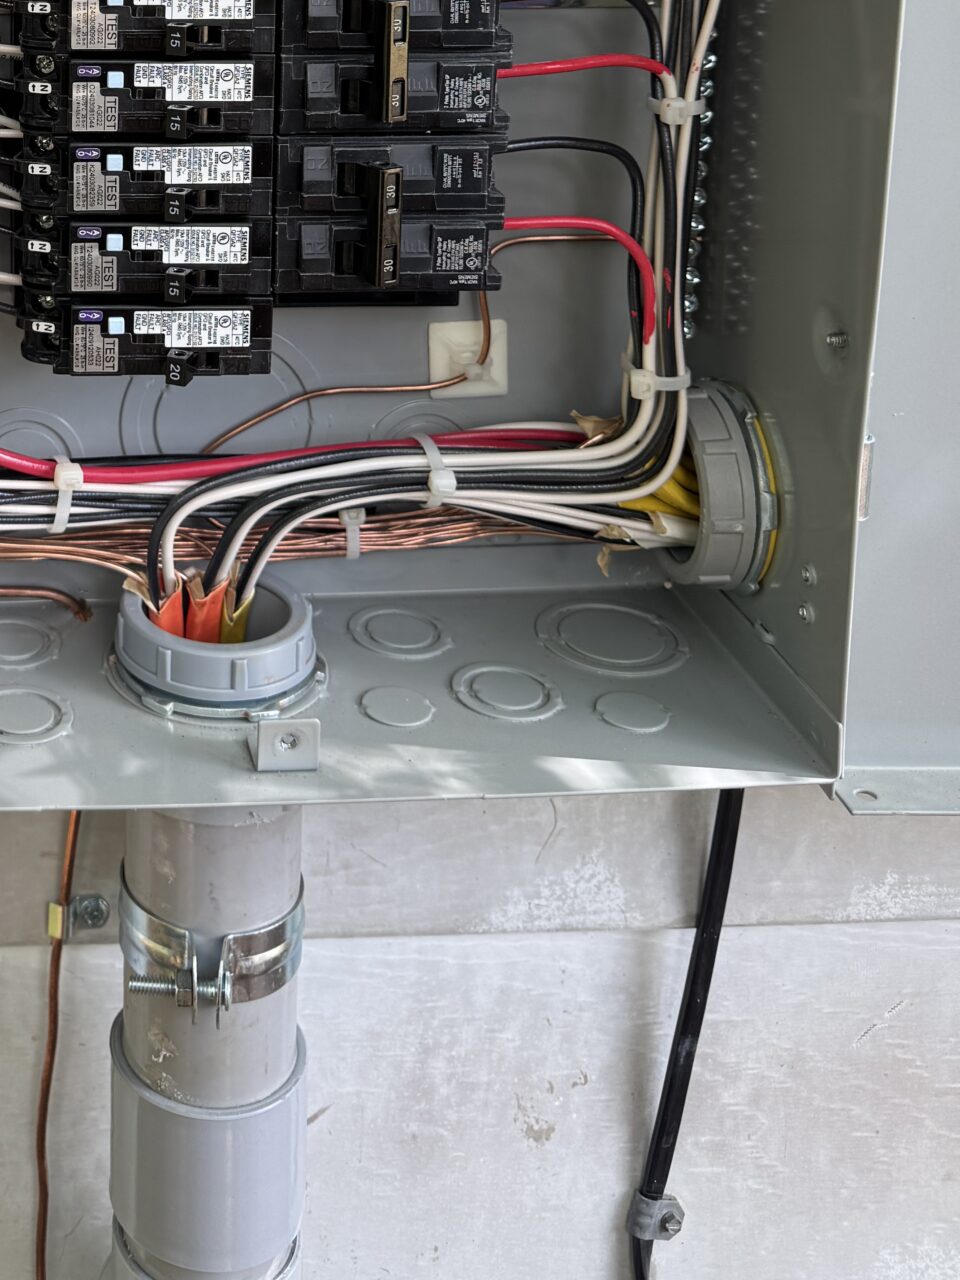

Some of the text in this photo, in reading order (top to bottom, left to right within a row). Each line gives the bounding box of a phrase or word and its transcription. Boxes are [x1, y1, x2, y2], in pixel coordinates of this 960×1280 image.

[106, 16, 118, 48] TEST
[170, 32, 181, 47] 15
[244, 66, 252, 99] SIEMENS
[106, 98, 116, 130] TEST
[170, 116, 180, 131] 15
[107, 178, 117, 209] TEST
[386, 185, 396, 199] 30
[169, 200, 179, 215] 15
[240, 230, 248, 262] SIEMENS
[103, 258, 114, 290] TEST
[383, 259, 393, 273] 30
[168, 280, 180, 296] 15
[105, 340, 115, 371] TEST
[169, 363, 180, 381] 20
